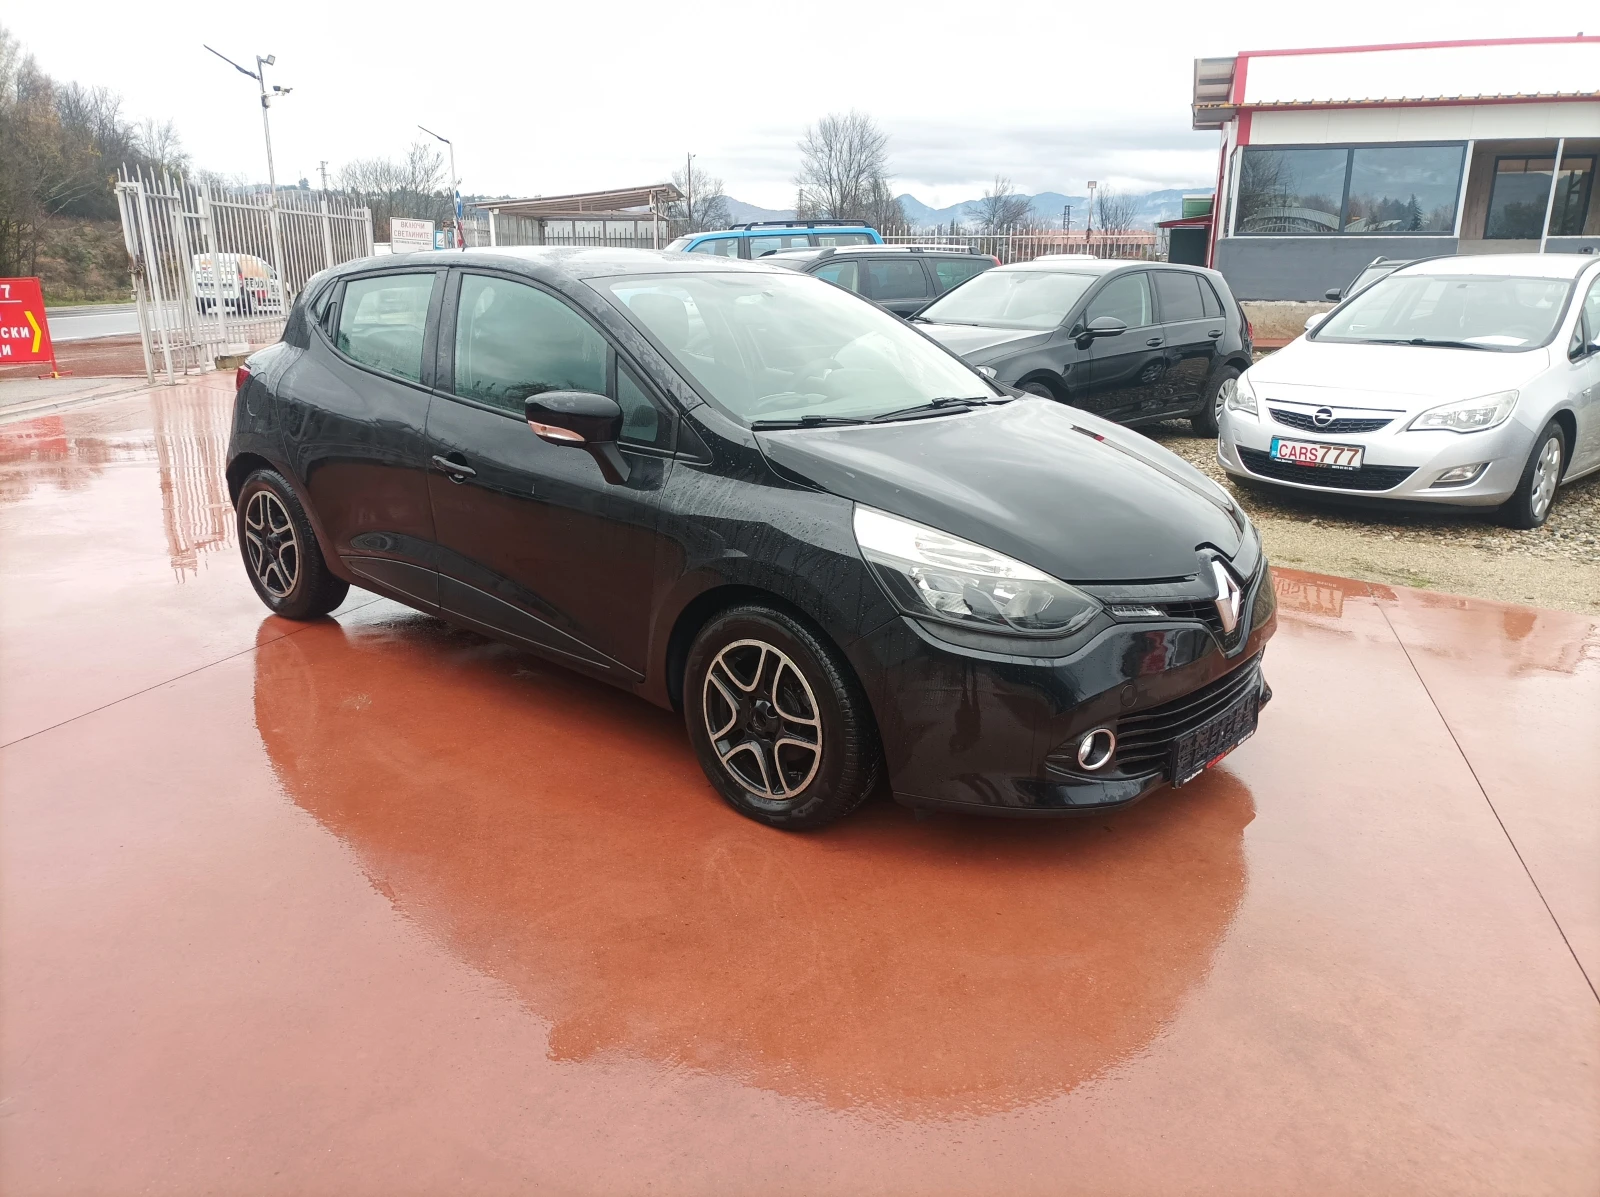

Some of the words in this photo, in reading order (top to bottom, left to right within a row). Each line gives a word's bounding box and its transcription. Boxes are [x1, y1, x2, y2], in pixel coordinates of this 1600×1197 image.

[400, 221, 425, 230] ВКЛЮЧИ
[0, 344, 12, 357] И
[1279, 443, 1360, 466] CARS777
